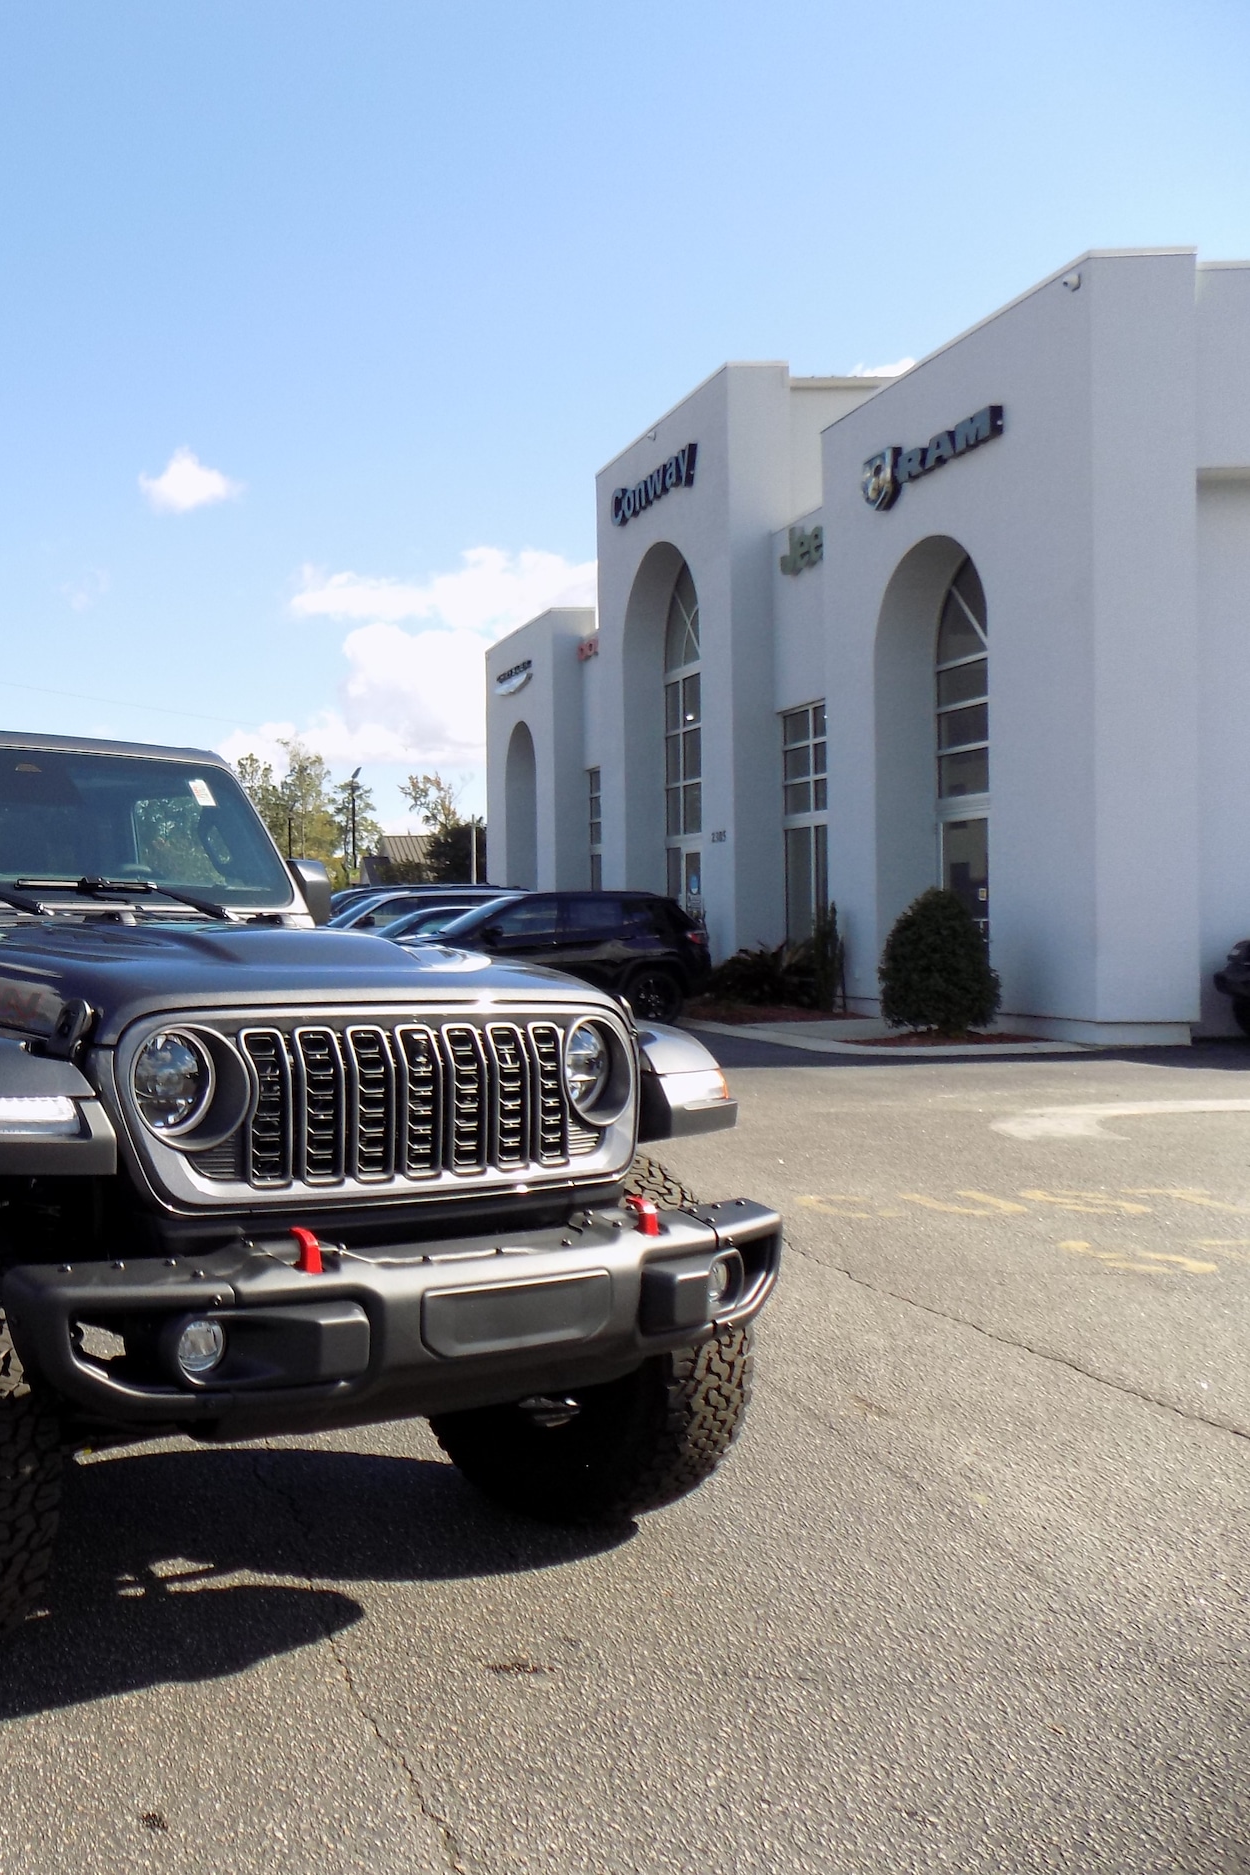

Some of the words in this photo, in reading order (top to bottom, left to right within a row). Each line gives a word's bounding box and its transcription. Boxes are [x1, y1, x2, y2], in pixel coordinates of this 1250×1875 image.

[897, 405, 1003, 484] RAM
[611, 443, 697, 526] Conway
[780, 526, 823, 576] Jee
